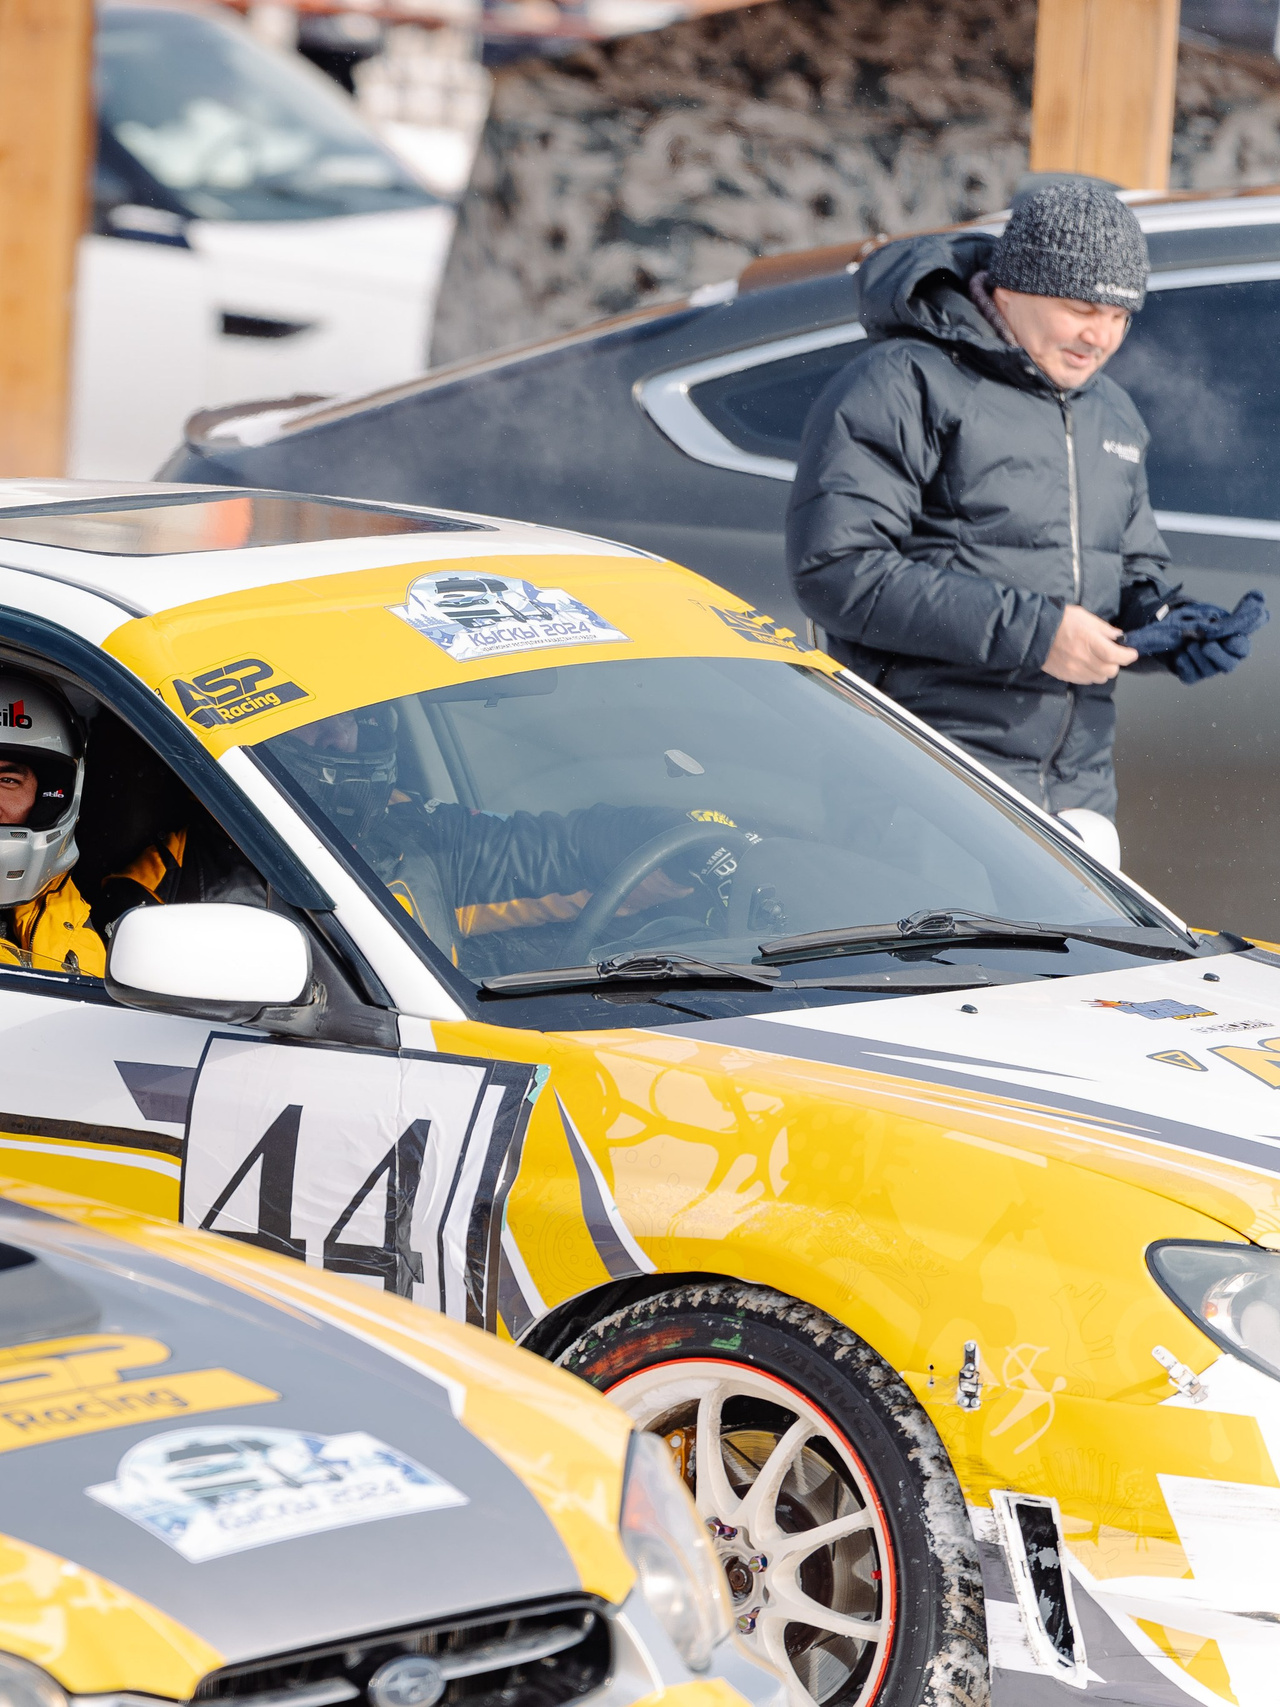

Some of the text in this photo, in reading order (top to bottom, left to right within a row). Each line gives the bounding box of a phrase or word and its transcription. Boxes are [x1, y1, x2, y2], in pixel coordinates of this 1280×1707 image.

[544, 621, 591, 636] 2024
[172, 658, 274, 717] ASP
[218, 691, 282, 722] Racing
[197, 1104, 432, 1302] 44
[0, 1385, 190, 1434] Racing
